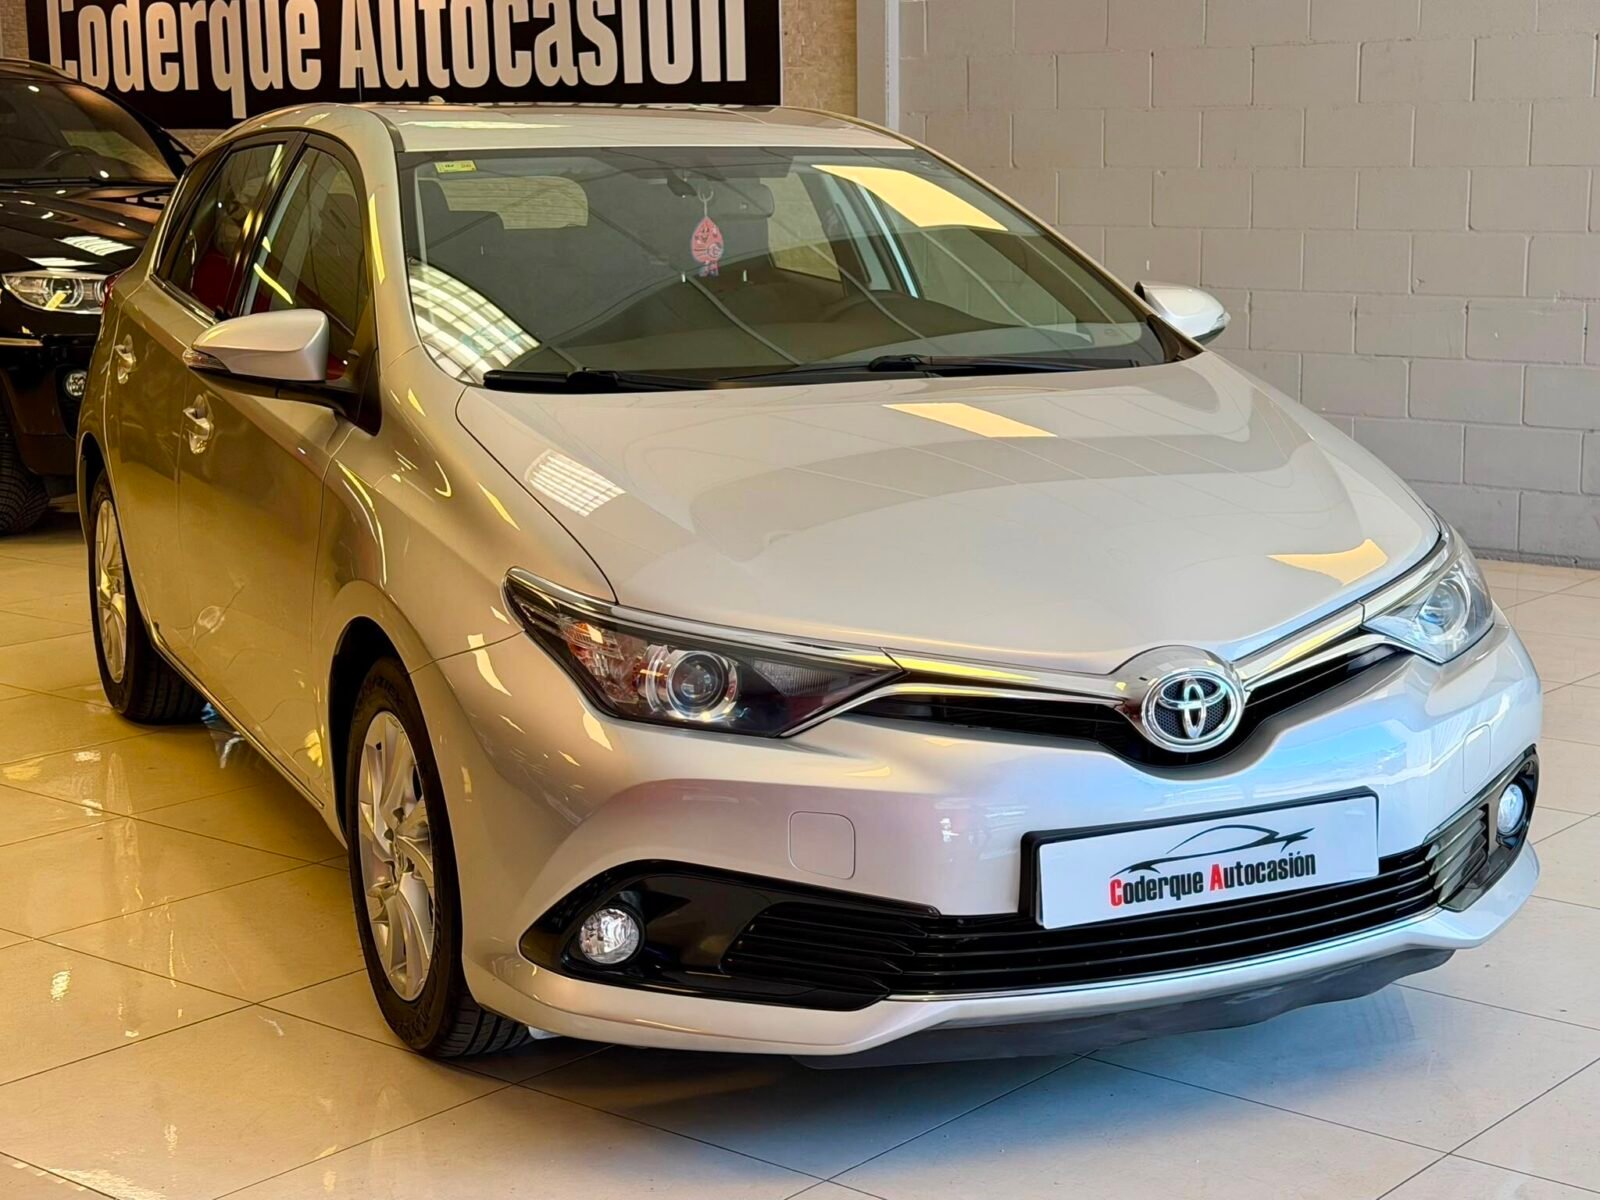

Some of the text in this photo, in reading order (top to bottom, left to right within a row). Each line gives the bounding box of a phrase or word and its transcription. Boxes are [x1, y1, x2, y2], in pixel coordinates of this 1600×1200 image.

[48, 0, 322, 119] Coderque
[1109, 851, 1316, 907] Coderque Autocasión
